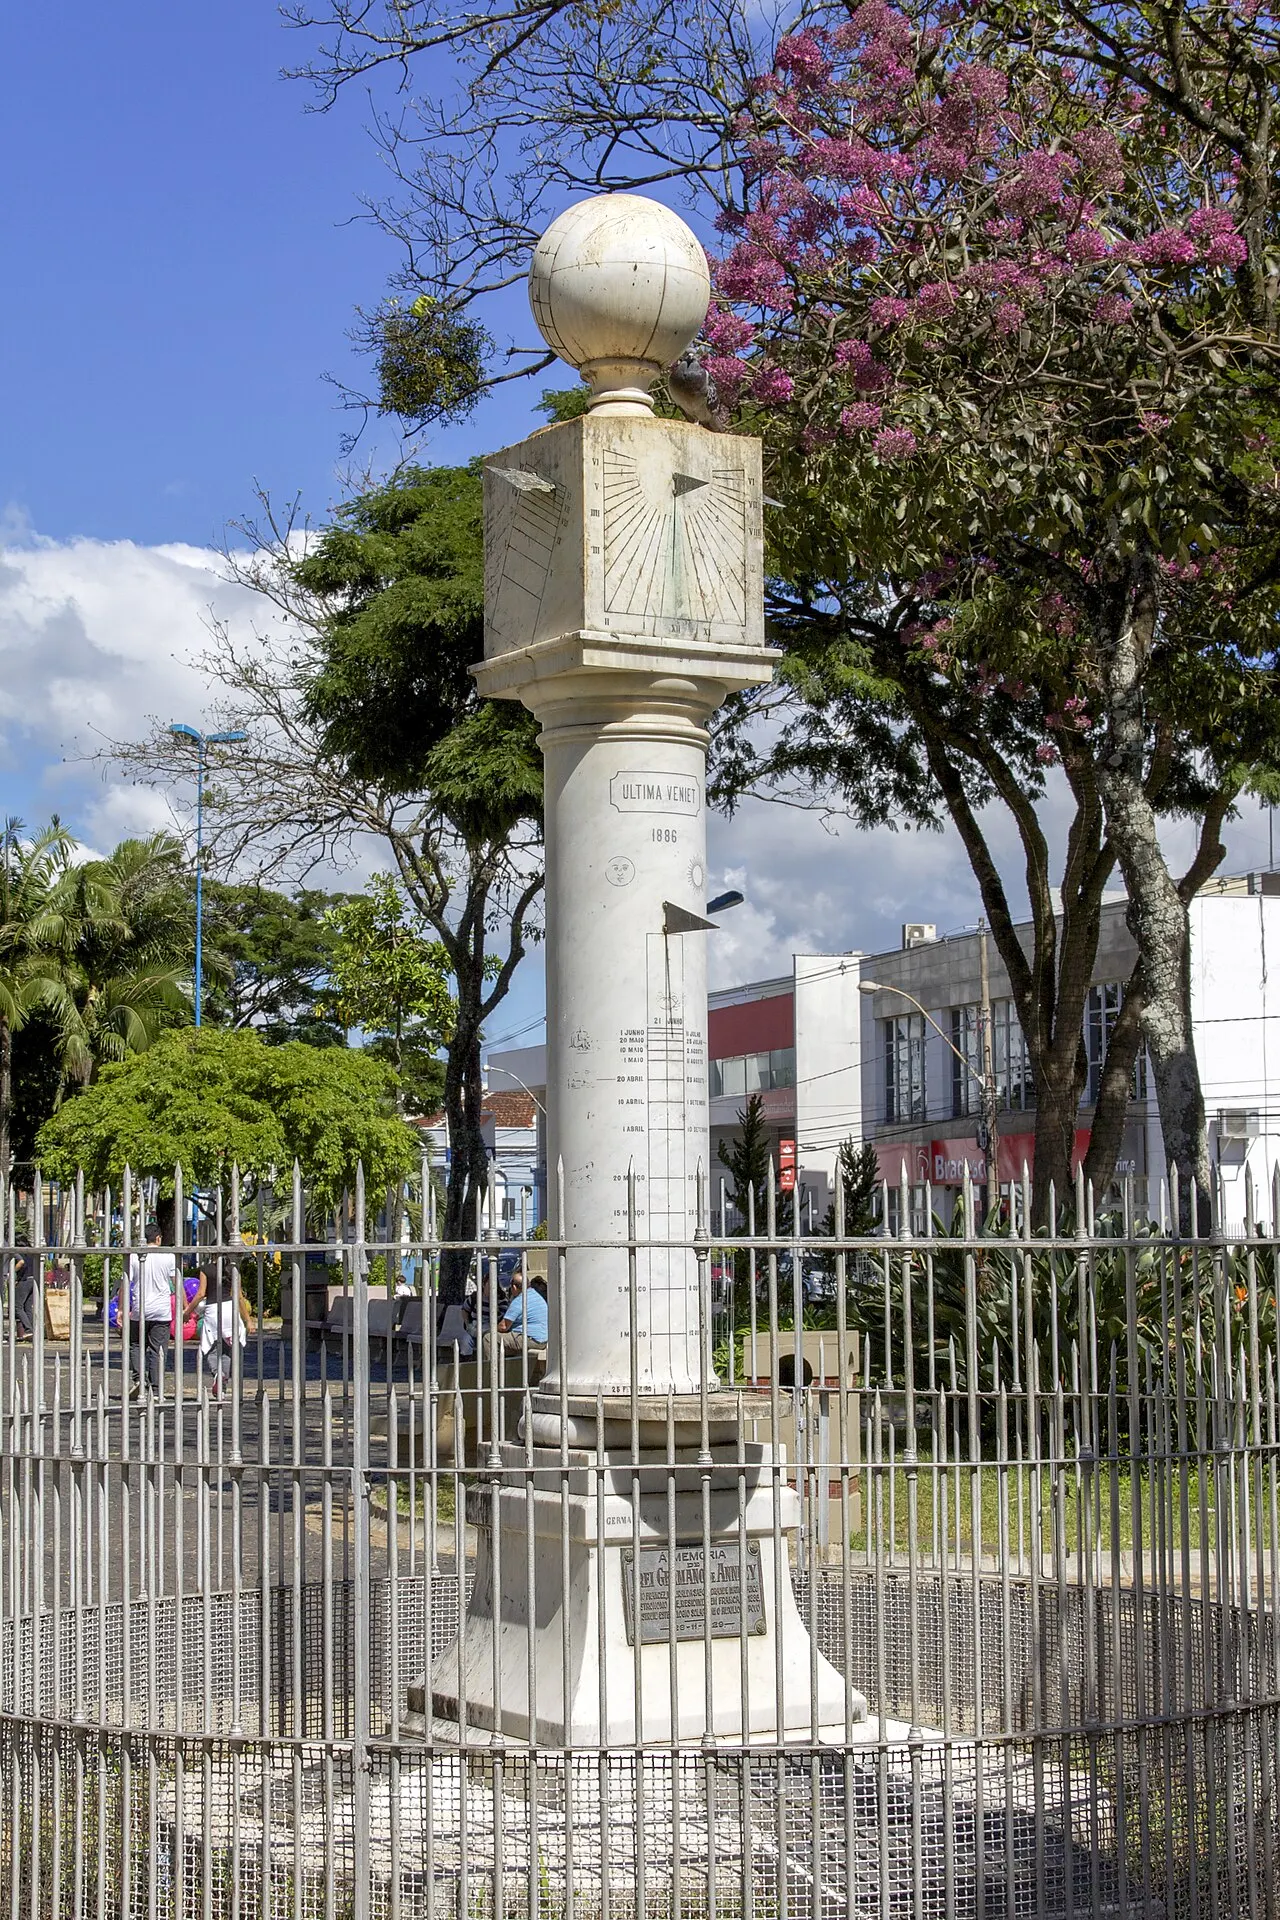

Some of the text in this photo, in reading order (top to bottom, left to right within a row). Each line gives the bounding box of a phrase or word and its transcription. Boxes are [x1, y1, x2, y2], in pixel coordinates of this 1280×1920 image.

[622, 784, 695, 803] ULTIMA VENIET
[652, 828, 677, 843] 1886
[653, 1017, 662, 1025] 21
[623, 1174, 645, 1182] MÇO
[613, 1209, 645, 1218] 15 MÇO
